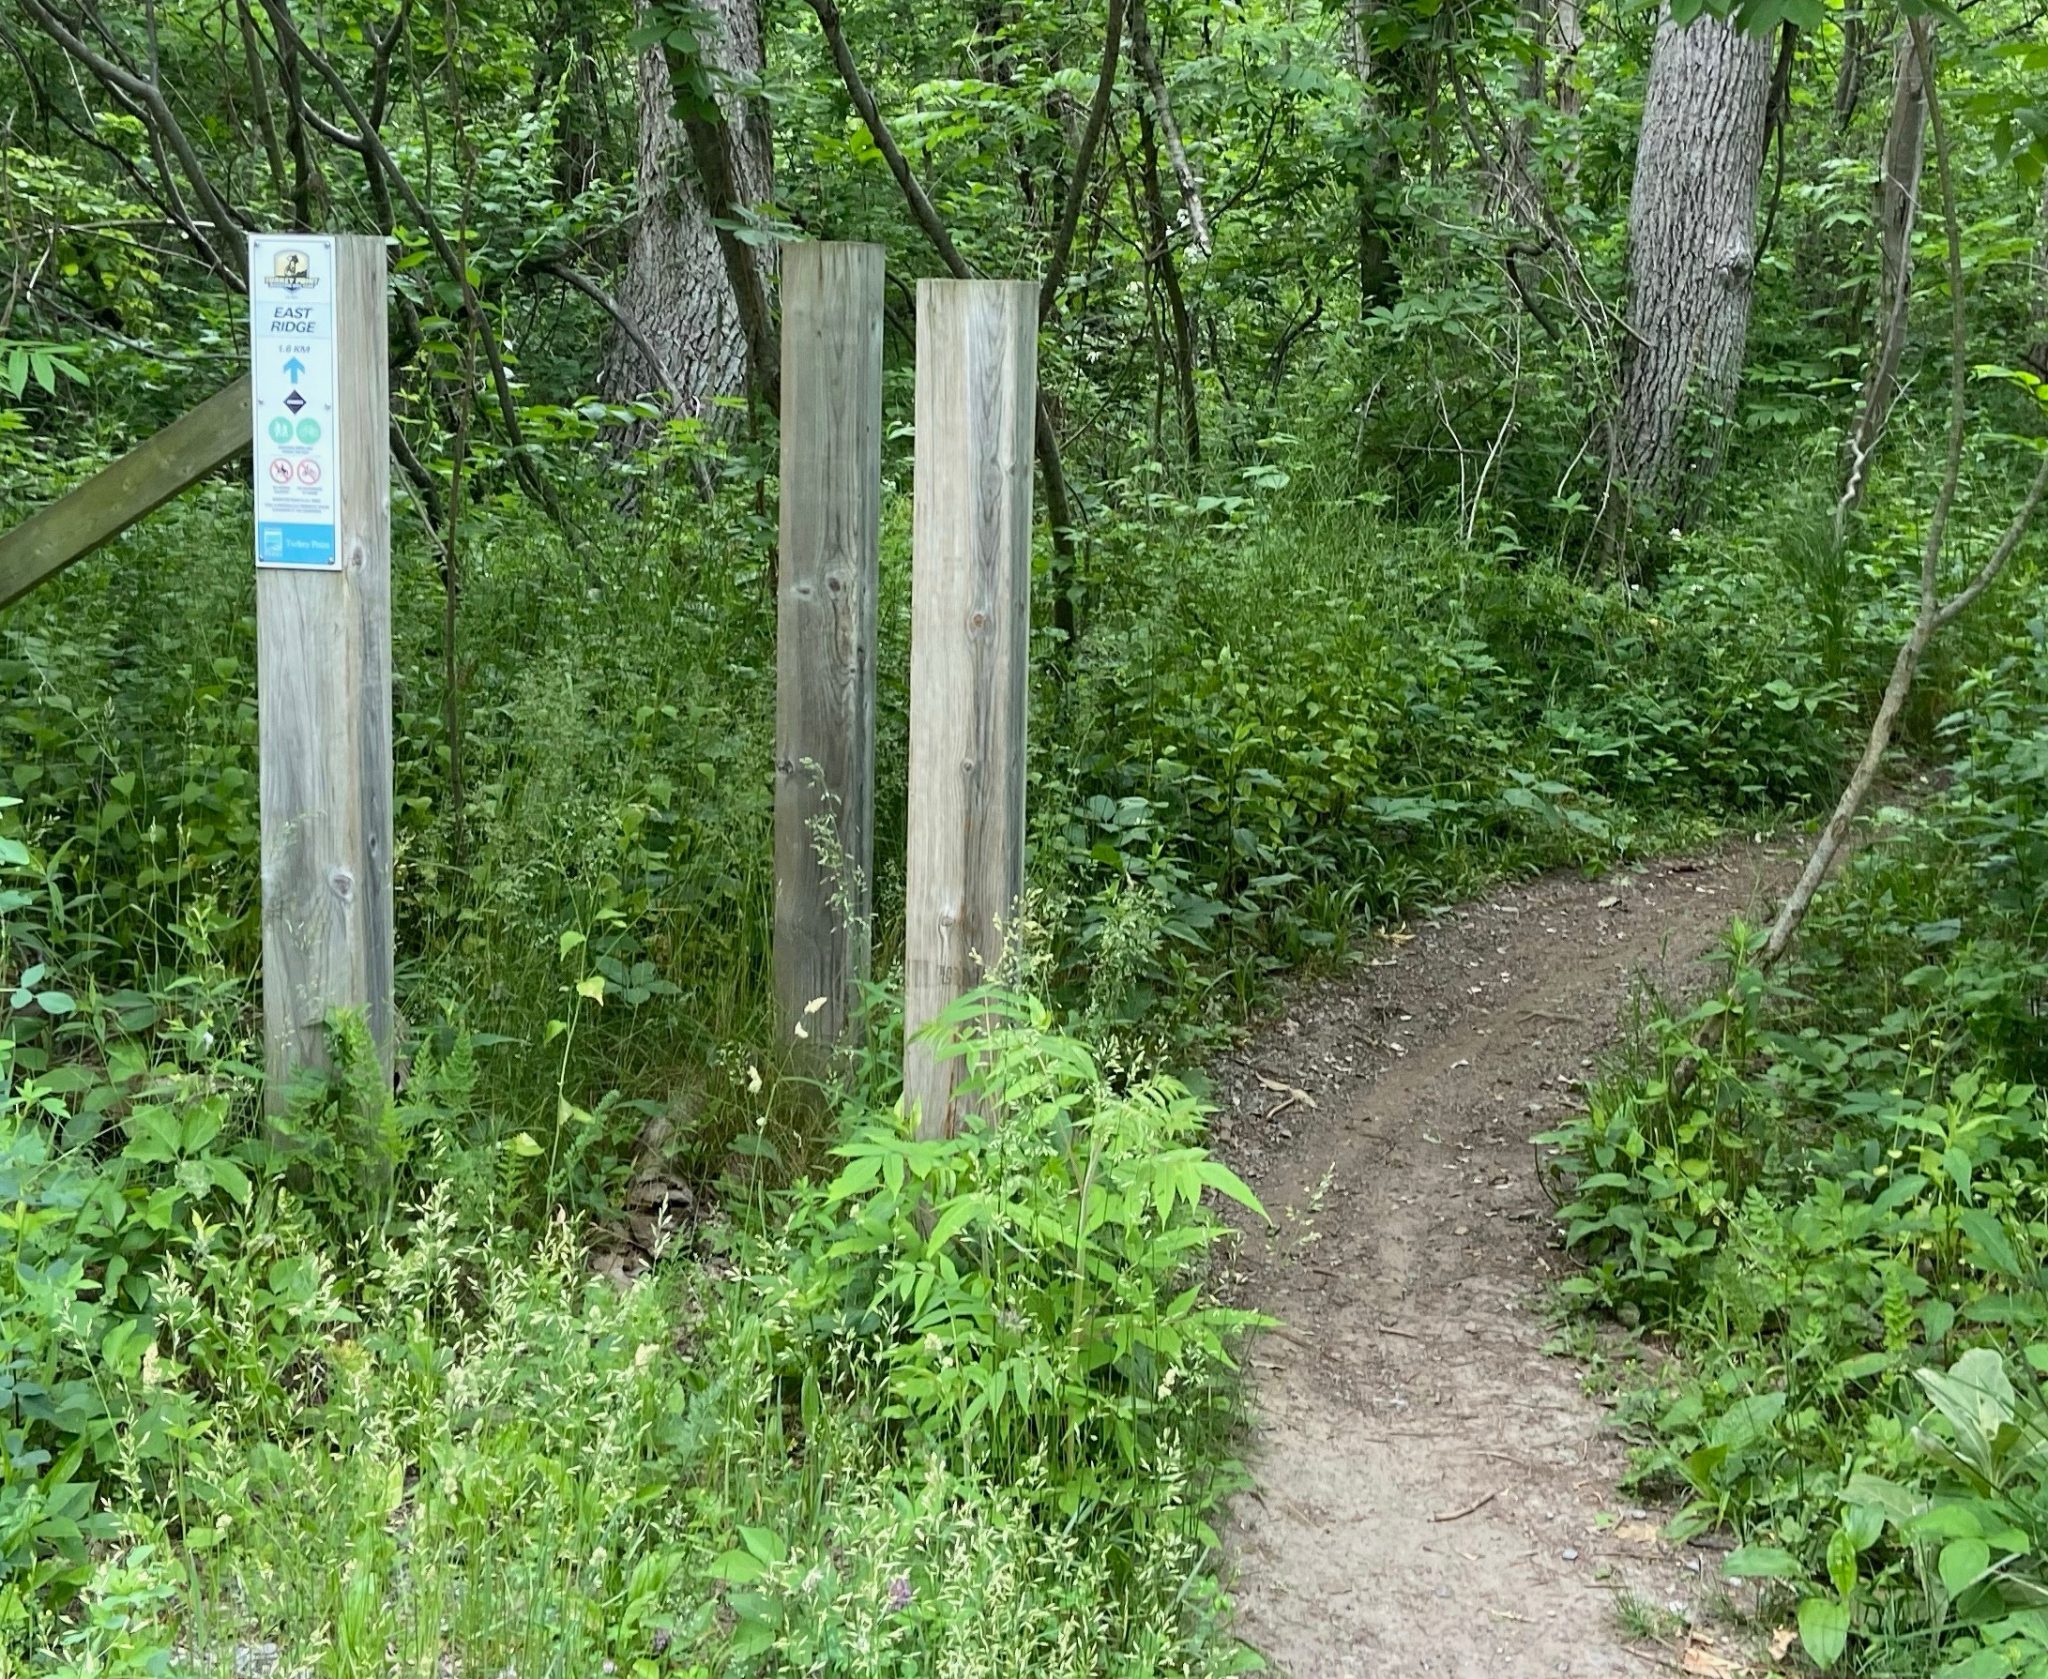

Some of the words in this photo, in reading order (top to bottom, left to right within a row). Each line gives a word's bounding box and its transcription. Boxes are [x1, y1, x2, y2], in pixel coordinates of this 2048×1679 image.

[274, 307, 313, 319] EAST
[271, 321, 316, 333] RIDGE
[293, 345, 310, 353] KM
